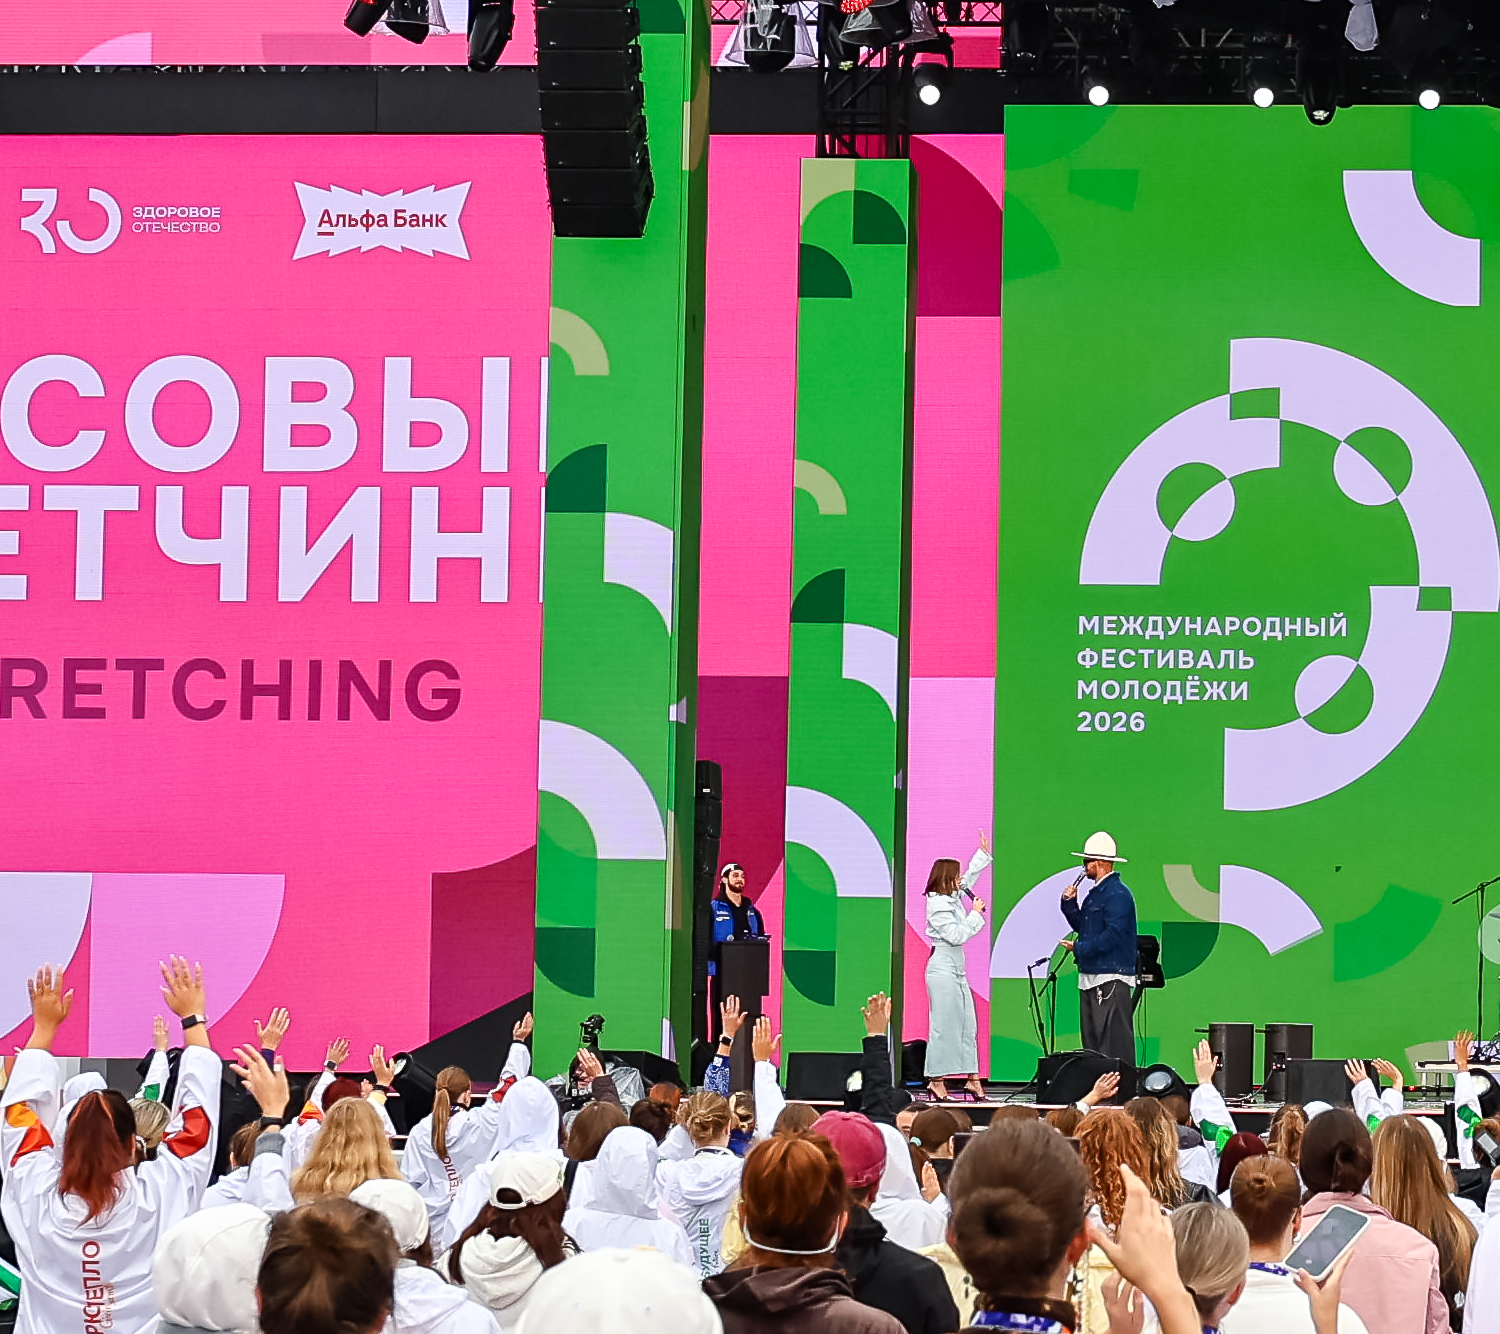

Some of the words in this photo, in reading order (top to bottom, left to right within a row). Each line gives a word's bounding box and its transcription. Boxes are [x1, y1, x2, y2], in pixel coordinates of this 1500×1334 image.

[132, 207, 221, 219] ЗДОРОВОЕ
[317, 208, 389, 234] Альфа
[393, 208, 447, 228] Банк
[132, 222, 221, 233] ОТЕЧЕСТВО
[1079, 613, 1346, 640] МЕЖДУНАРОДНЫЙ
[1078, 648, 1254, 669] ФЕСТИВАЛЬ
[1078, 676, 1247, 704] МОЛОДЁЖИ
[1077, 712, 1144, 731] 2026
